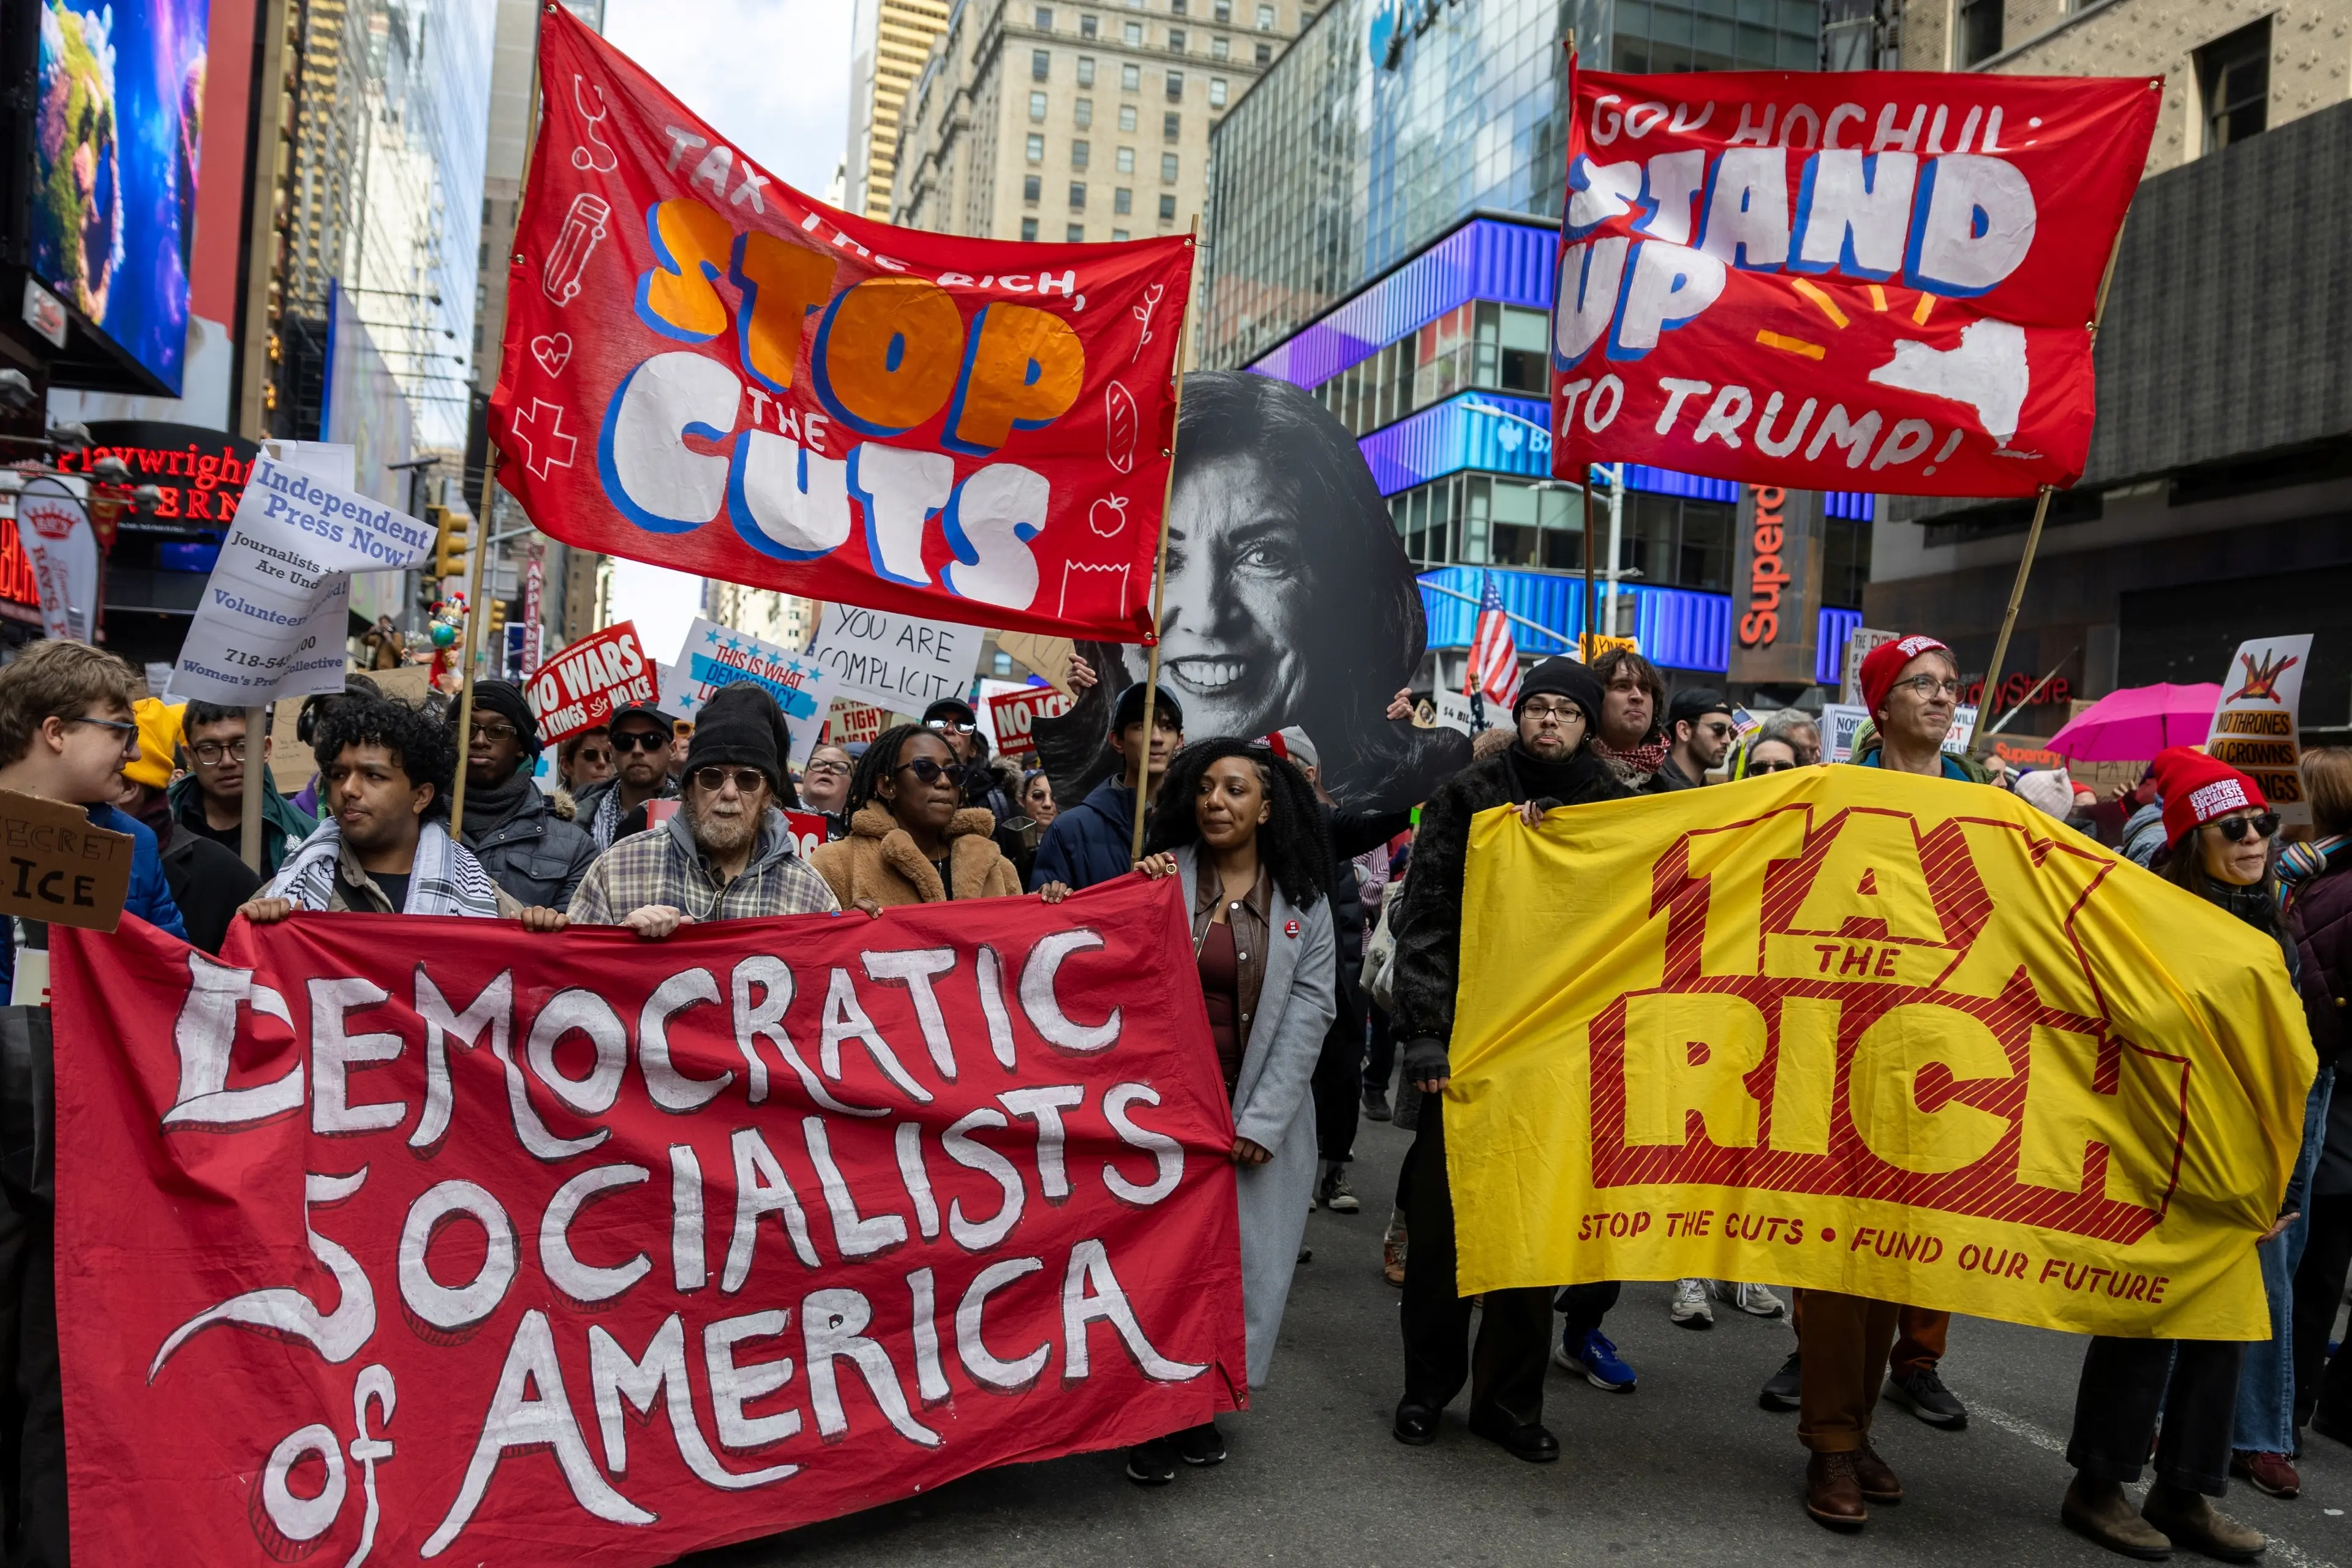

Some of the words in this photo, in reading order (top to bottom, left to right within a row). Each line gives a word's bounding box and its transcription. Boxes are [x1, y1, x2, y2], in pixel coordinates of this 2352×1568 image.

[1591, 94, 1715, 146] GOV
[666, 124, 771, 214] TAX
[937, 270, 1085, 312] RICH,
[1561, 147, 2037, 298] STAND
[634, 197, 1086, 456] STOP
[1553, 236, 1727, 372] UP
[746, 388, 831, 453] THE
[1560, 373, 1625, 439] TO
[1654, 374, 1964, 477] TRUMP!
[598, 351, 1050, 611] CUTS
[257, 460, 429, 551] Independent
[231, 530, 320, 574] Journalists
[263, 493, 344, 543] Press
[349, 527, 413, 570] Now!
[255, 559, 285, 579] Are
[290, 570, 321, 590] Und
[1739, 483, 1791, 645] Superd
[214, 588, 307, 627] Volunteer
[834, 603, 886, 641] YOU
[895, 624, 954, 663] ARE
[182, 659, 251, 687] Women's
[282, 656, 344, 677] Collective
[527, 673, 559, 720] NO
[558, 633, 643, 701] WARS
[706, 663, 797, 709] DEMACY
[715, 644, 748, 670] THIS
[747, 657, 764, 675] IS
[763, 662, 805, 690] WHAT
[608, 685, 631, 709] NO
[628, 675, 654, 701] ICE
[830, 702, 846, 712] TAX
[849, 700, 870, 709] TH
[545, 701, 588, 736] KINGS
[843, 707, 884, 733] FIGHT
[994, 701, 1033, 739] NO
[1947, 726, 1964, 741] OT
[2215, 712, 2233, 734] NO
[2233, 712, 2291, 736] THRONES
[1002, 737, 1028, 749] HANDS
[2207, 740, 2225, 761] NO
[2225, 741, 2295, 765] CROWNS
[2188, 778, 2240, 803] DEMOCRATIC
[2191, 786, 2245, 812] SOCIALISTS
[2195, 808, 2208, 822] OF
[2208, 796, 2250, 817] AMERICA
[2255, 773, 2301, 802] NGS
[5, 818, 127, 861] ECRET
[10, 856, 96, 908] ICE
[1813, 944, 1902, 979] THE
[160, 927, 1123, 1162] DEMOCRATIC
[1589, 987, 2192, 1246] RICH
[146, 1081, 1185, 1387] SOCIALISTS
[1577, 1210, 1652, 1243] STOP
[1665, 1209, 1715, 1239] THE
[1725, 1212, 1804, 1246] CUTS
[1850, 1227, 1943, 1264] FUND
[1958, 1243, 2029, 1281] OUR
[2038, 1257, 2170, 1305] FUTURE
[252, 1362, 398, 1568] of
[419, 1238, 1212, 1560] AMERICA
